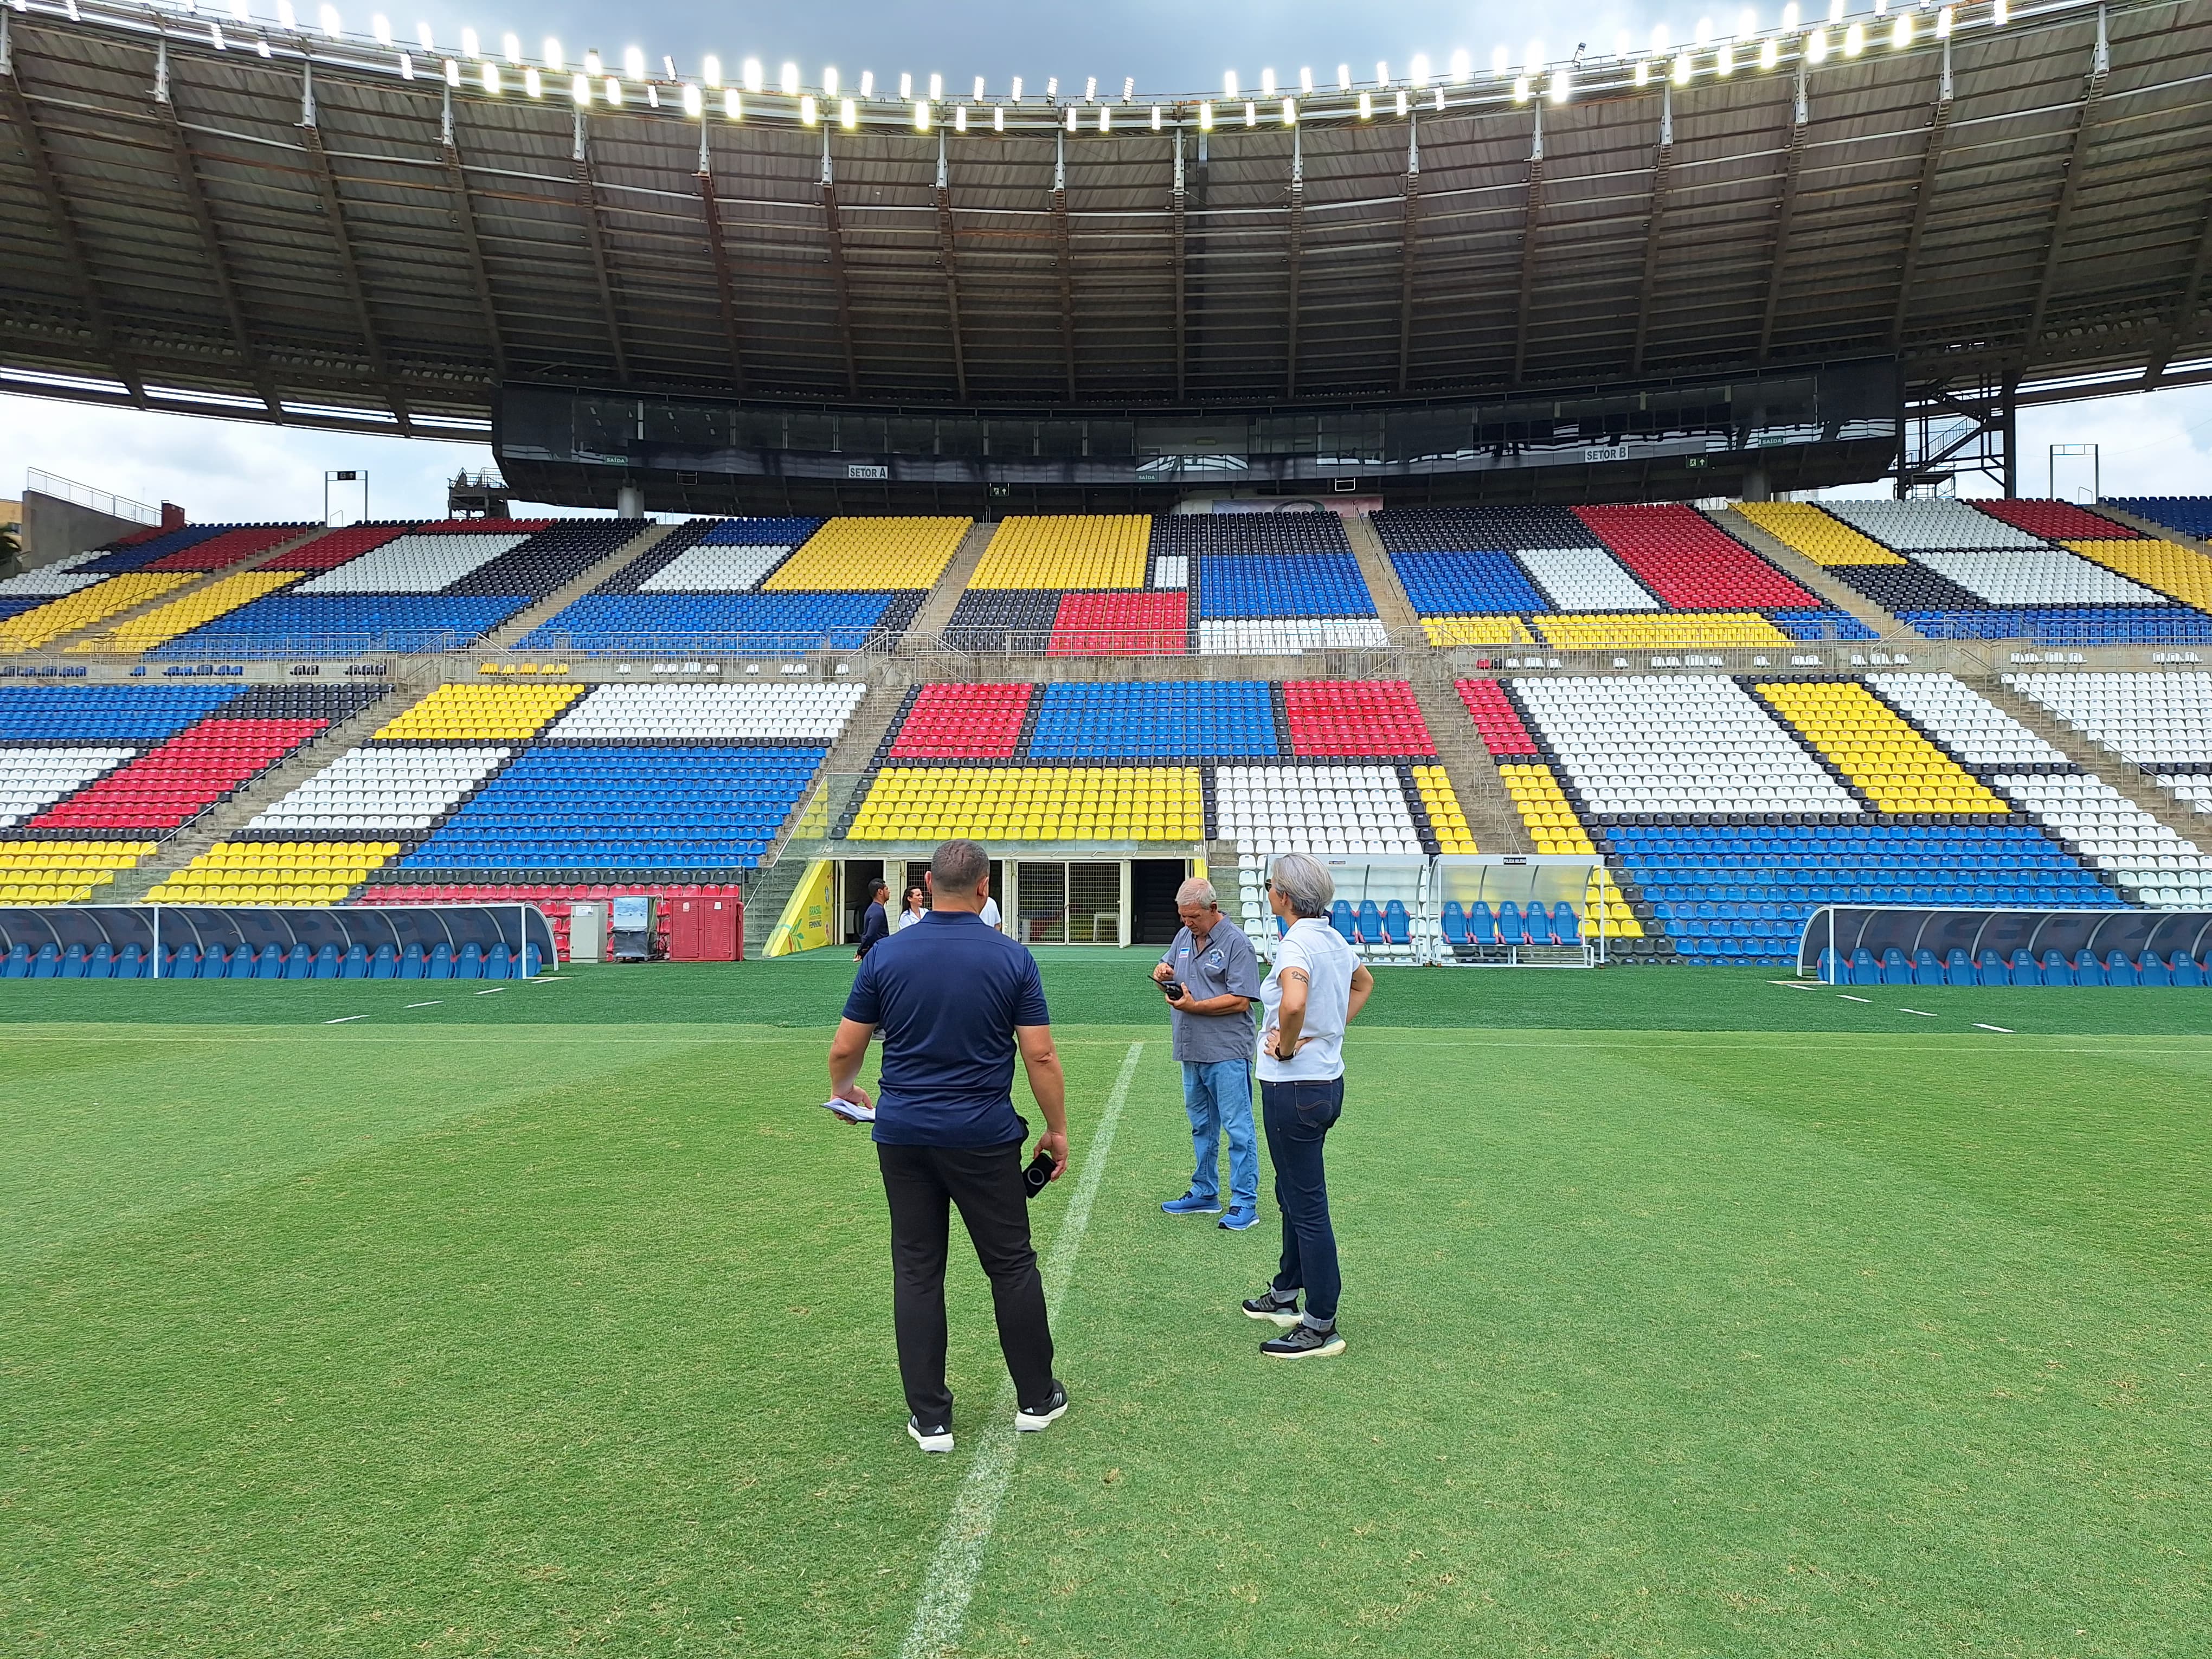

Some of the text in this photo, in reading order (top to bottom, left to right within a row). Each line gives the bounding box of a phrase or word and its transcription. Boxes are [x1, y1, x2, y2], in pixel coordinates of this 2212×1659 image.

[1587, 447, 1626, 460] SETOR B
[850, 467, 886, 478] SETOR A
[809, 905, 822, 916] BRASIL
